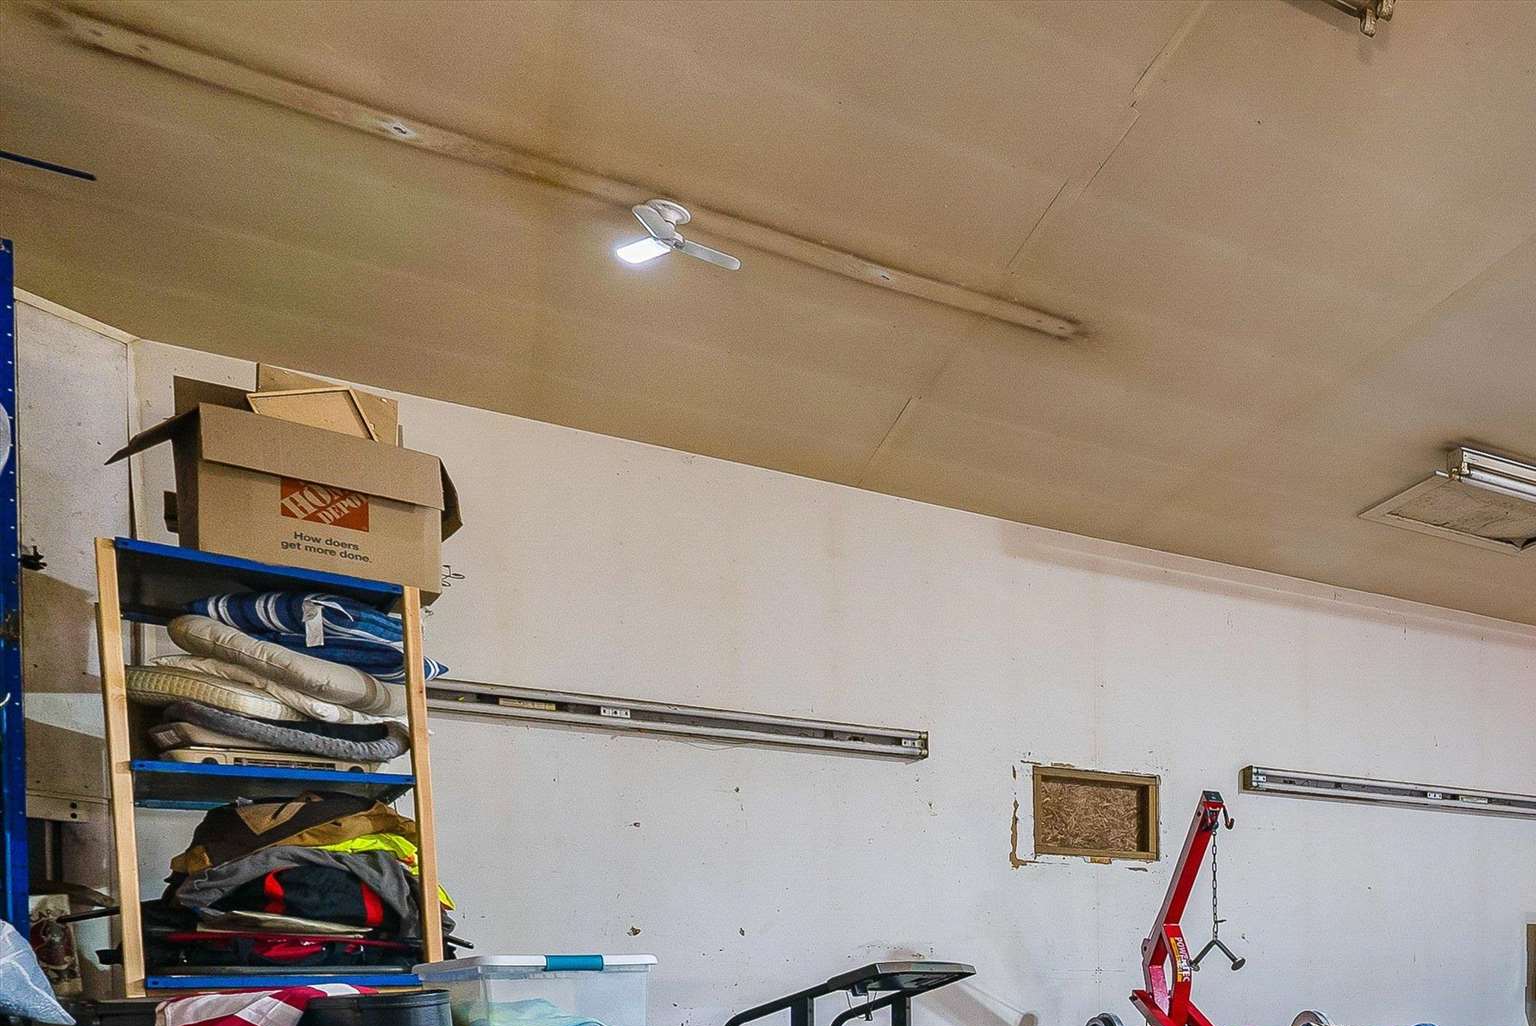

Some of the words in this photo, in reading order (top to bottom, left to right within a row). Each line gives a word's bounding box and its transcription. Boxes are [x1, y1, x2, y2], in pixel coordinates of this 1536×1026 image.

[294, 531, 321, 543] How
[325, 537, 359, 551] doers
[281, 541, 301, 550] get
[305, 545, 336, 556] more
[339, 550, 373, 563] done.
